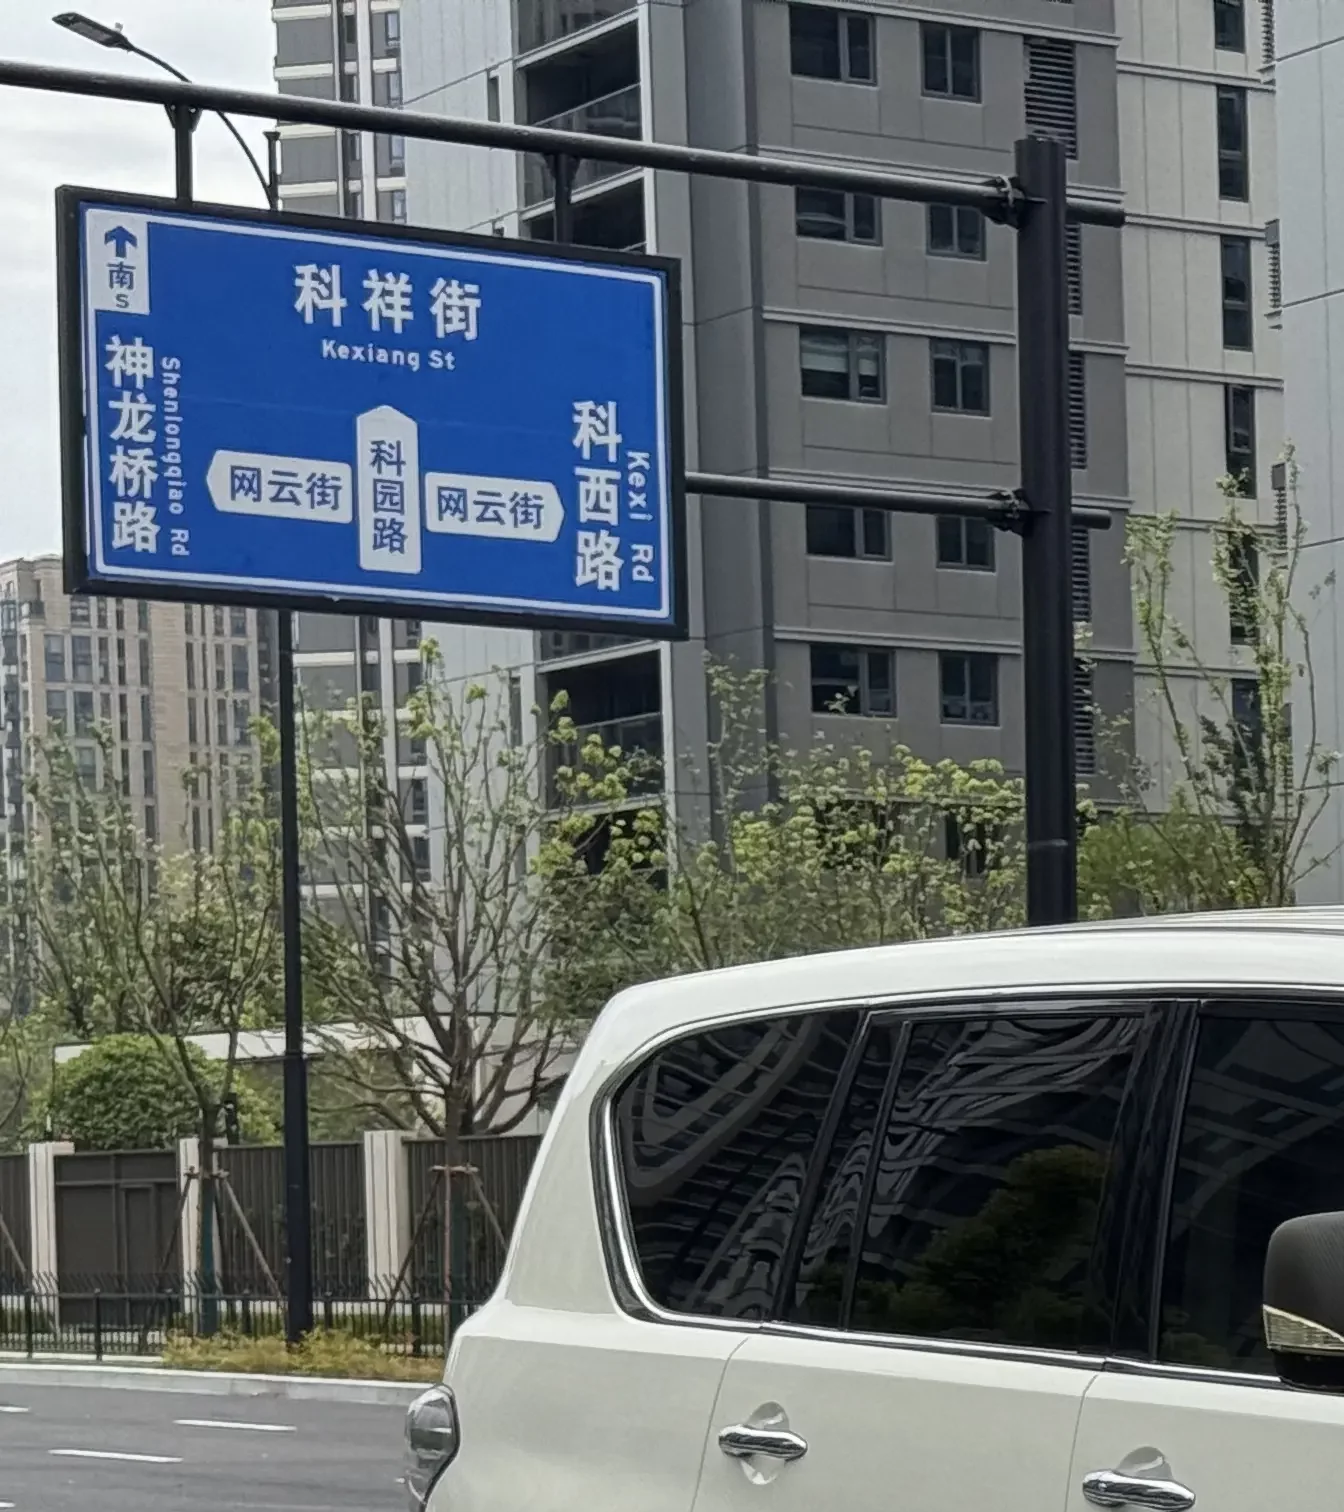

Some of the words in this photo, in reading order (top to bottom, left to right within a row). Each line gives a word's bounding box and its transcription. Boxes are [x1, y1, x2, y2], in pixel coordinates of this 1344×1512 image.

[106, 262, 136, 291] 南
[115, 293, 129, 309] S
[293, 263, 482, 341] 科祥街
[321, 339, 420, 372] Kexiang
[428, 350, 455, 370] St
[105, 334, 161, 554] 神龙桥路
[161, 356, 187, 515] Shenlongqiao
[230, 465, 342, 511] 网云街
[370, 440, 408, 554] 科园路
[437, 486, 545, 530] 网云街
[573, 400, 624, 591] 科西路
[627, 451, 653, 521] Kexi
[170, 528, 190, 556] Rd
[631, 544, 654, 582] Rd
